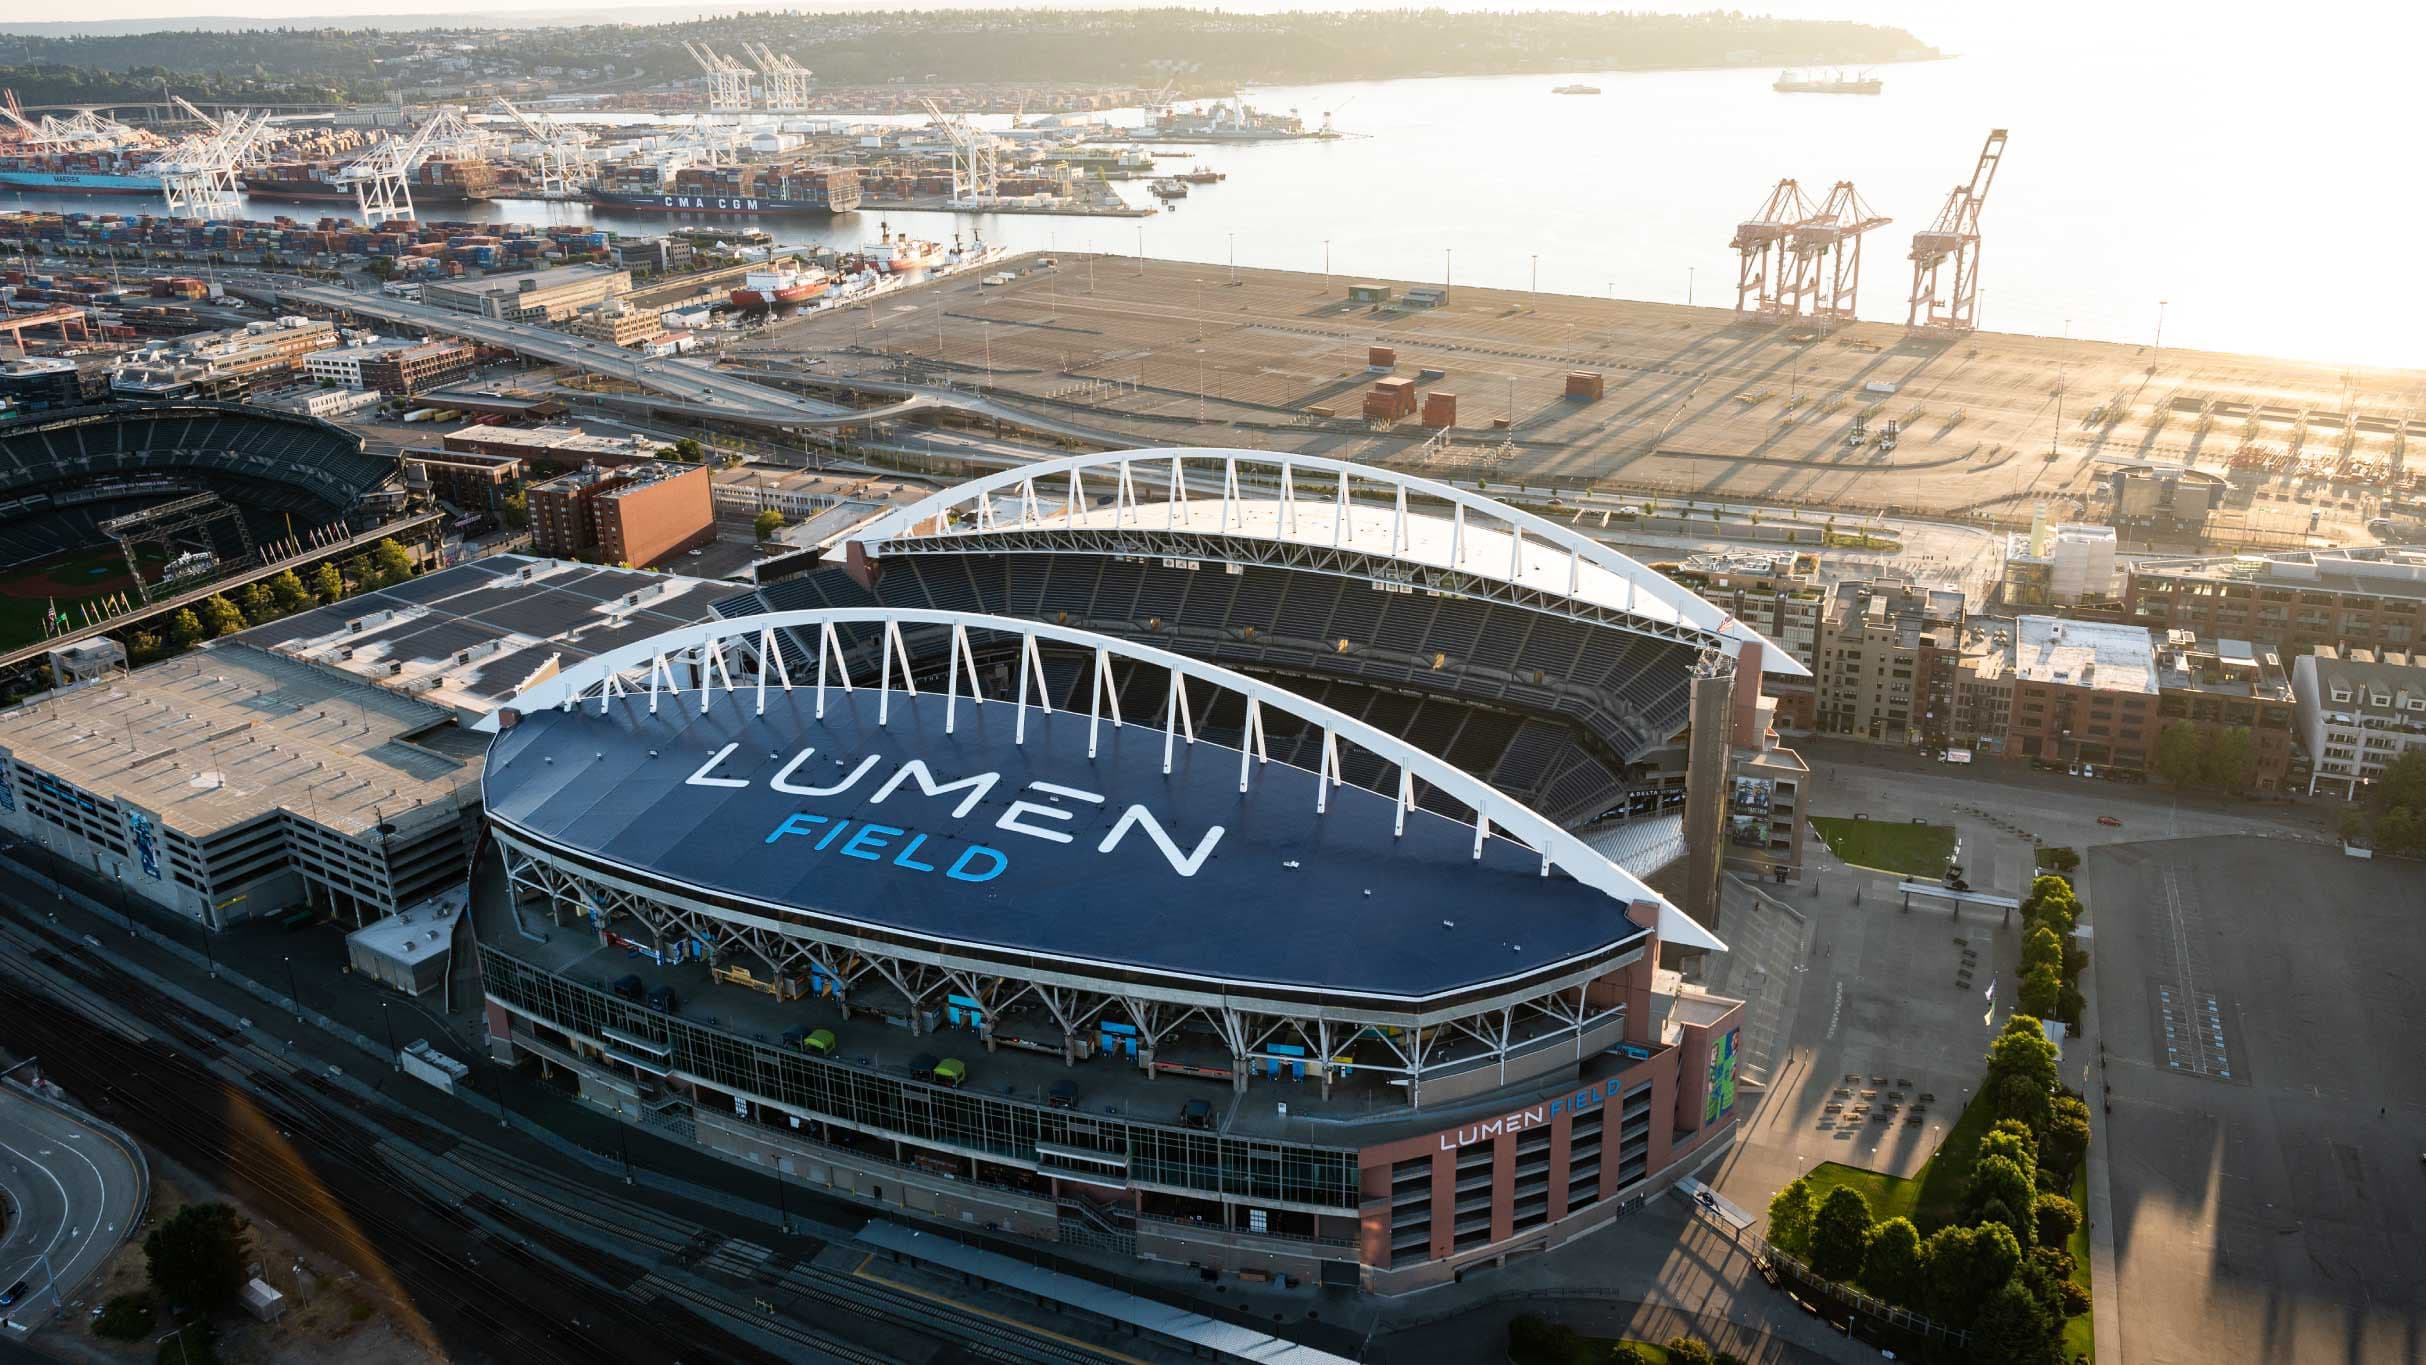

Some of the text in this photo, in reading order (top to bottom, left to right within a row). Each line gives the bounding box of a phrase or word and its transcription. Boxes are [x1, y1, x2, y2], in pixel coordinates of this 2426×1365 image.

[53, 175, 81, 183] MAERSK
[665, 197, 758, 210] CMA CGM
[685, 742, 1225, 877] LUMEN
[765, 813, 1008, 882] FIELD
[1440, 1079, 1621, 1151] LUMEN FIELD
